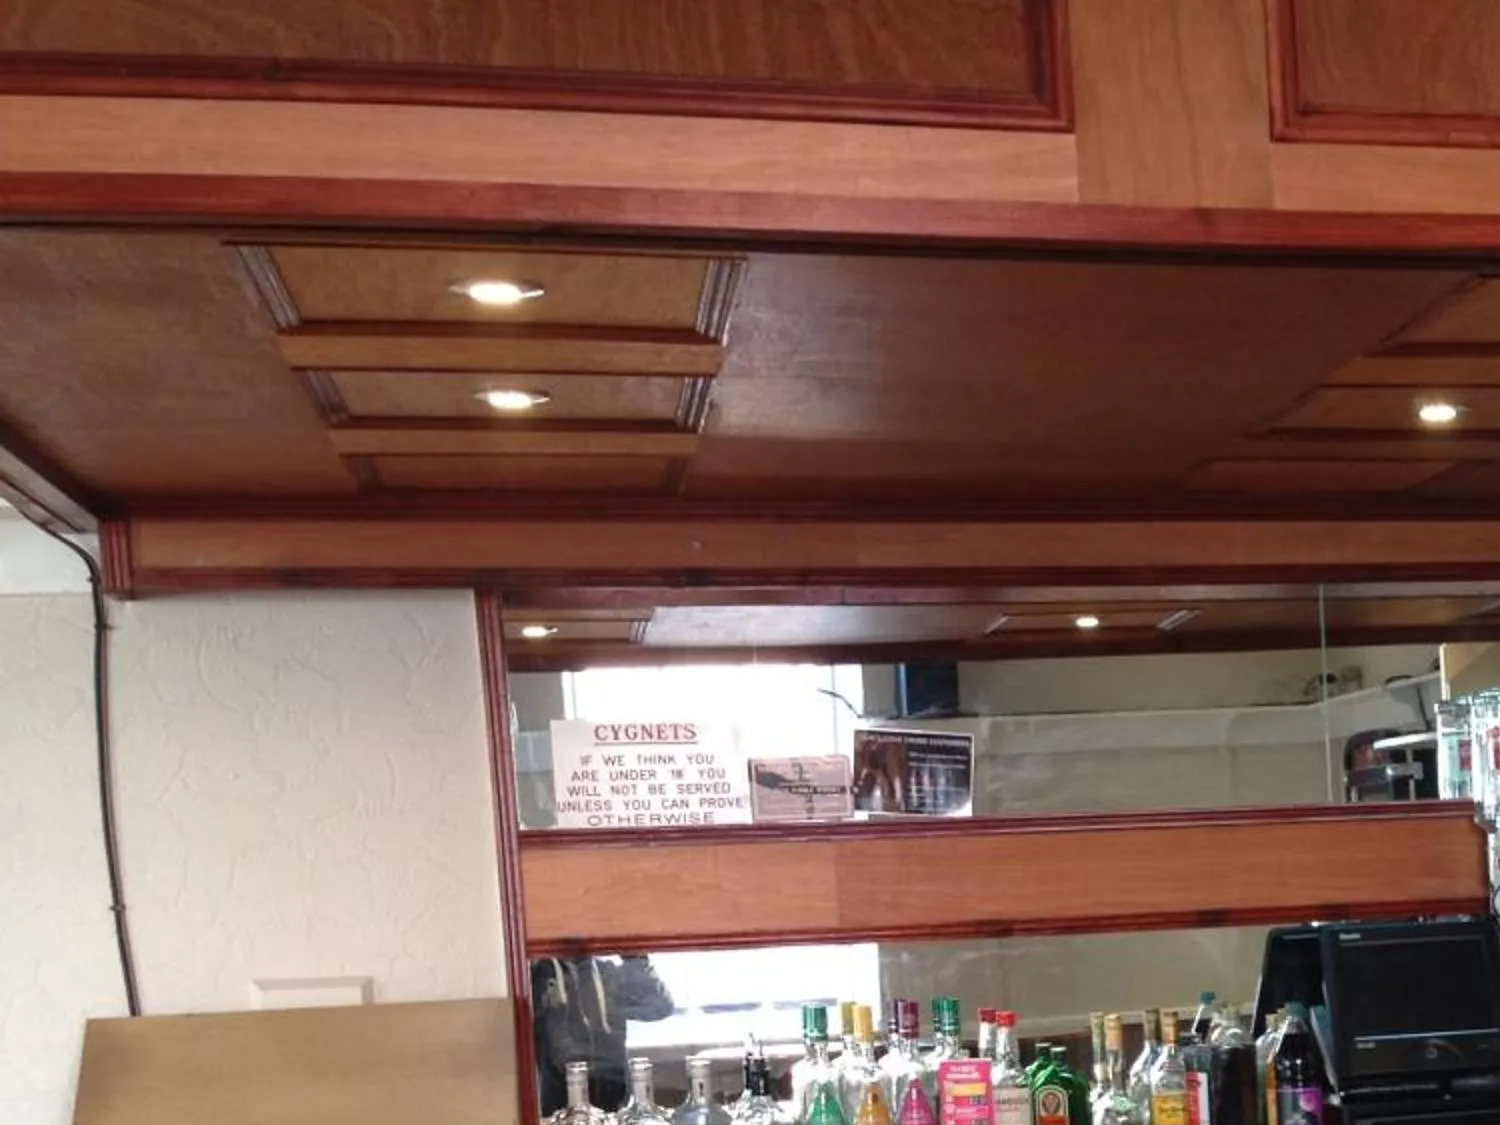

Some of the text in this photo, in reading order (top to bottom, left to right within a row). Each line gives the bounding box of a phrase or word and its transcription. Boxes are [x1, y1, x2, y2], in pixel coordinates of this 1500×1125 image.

[594, 723, 697, 741] CYGNETS
[580, 754, 715, 766] IF WE THINK YOU
[571, 770, 599, 782] ARE
[609, 770, 657, 782] UNDER
[698, 768, 726, 780] YOU
[567, 782, 731, 797] WILL NOT BE SERVED
[557, 797, 744, 813] UNLESS YOU CAN PROVE
[587, 811, 715, 827] OTHERWISE
